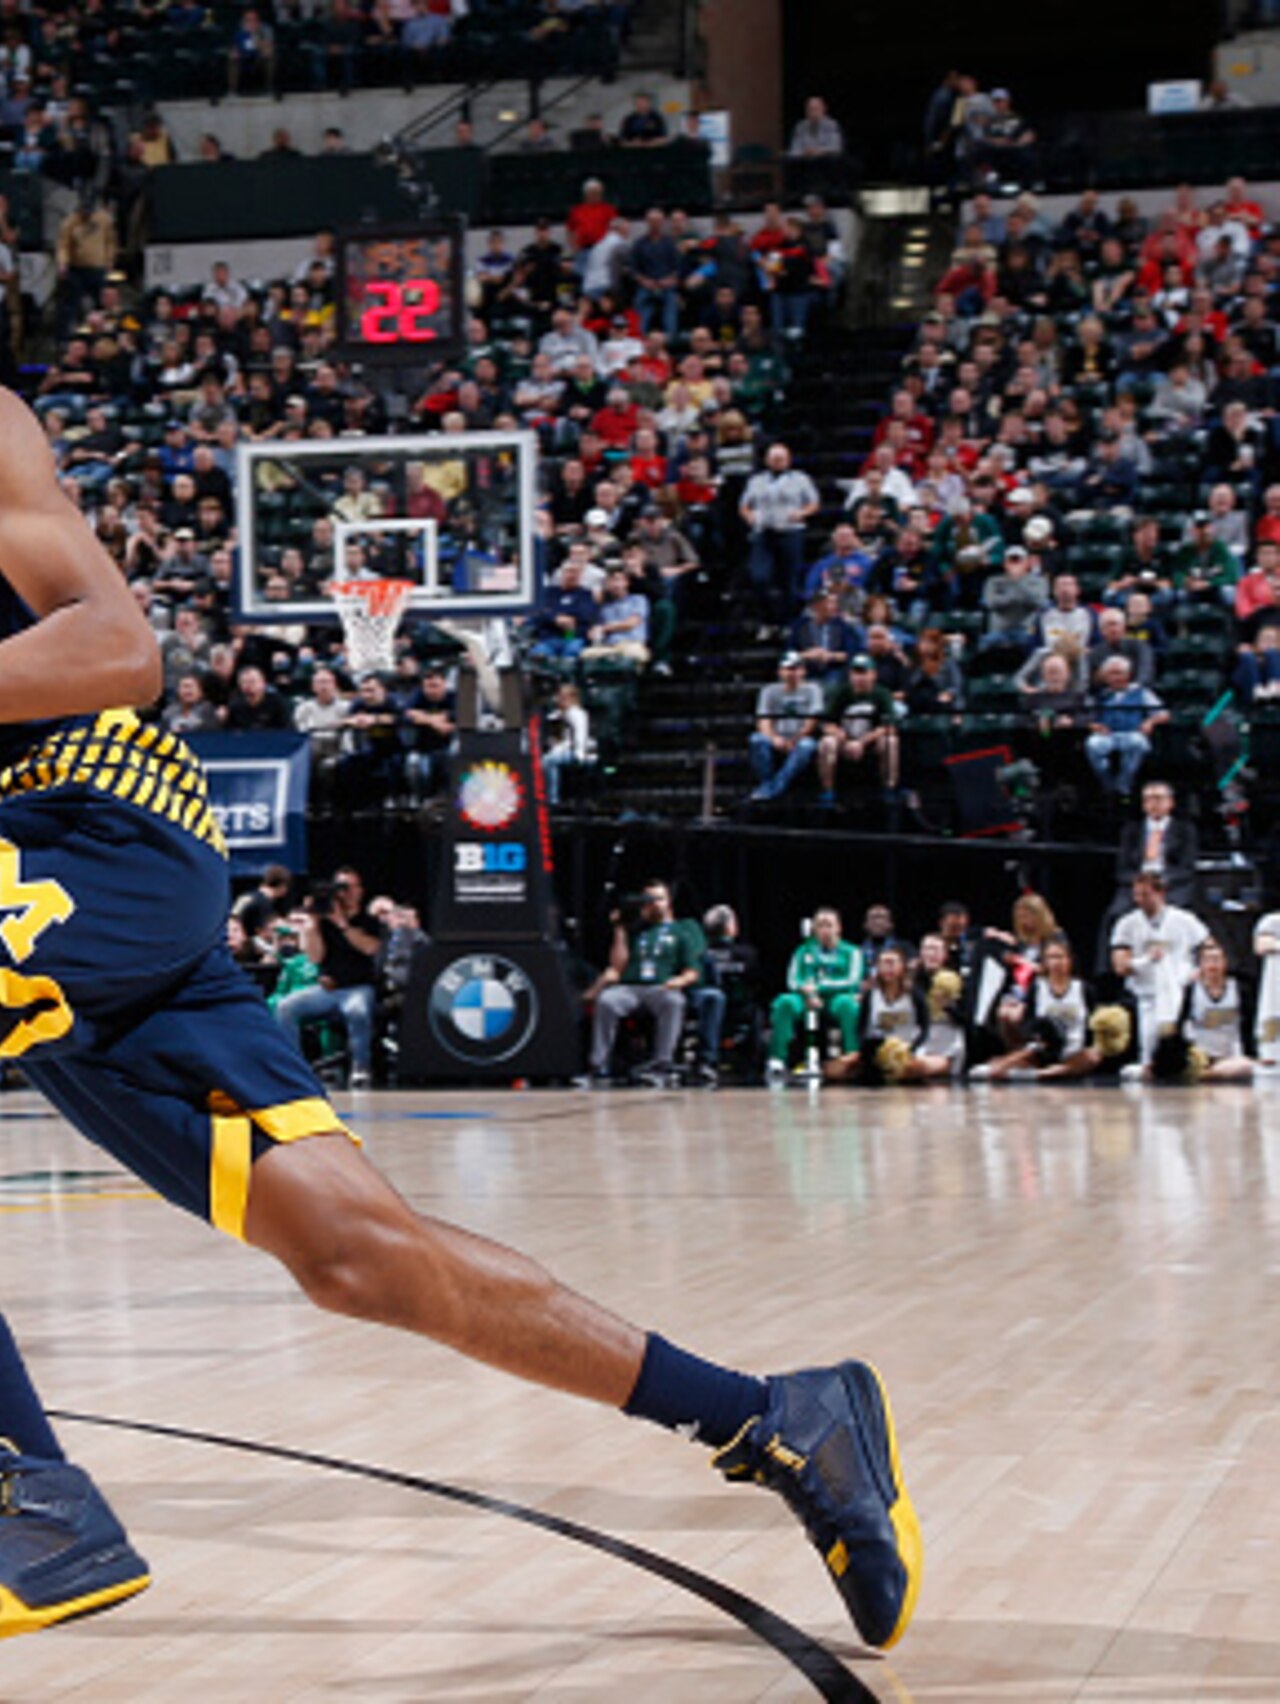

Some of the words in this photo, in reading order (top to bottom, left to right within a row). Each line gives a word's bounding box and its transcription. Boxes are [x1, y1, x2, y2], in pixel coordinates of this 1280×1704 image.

[361, 279, 440, 343] 22
[210, 803, 271, 832] RTS
[438, 960, 528, 992] BMW
